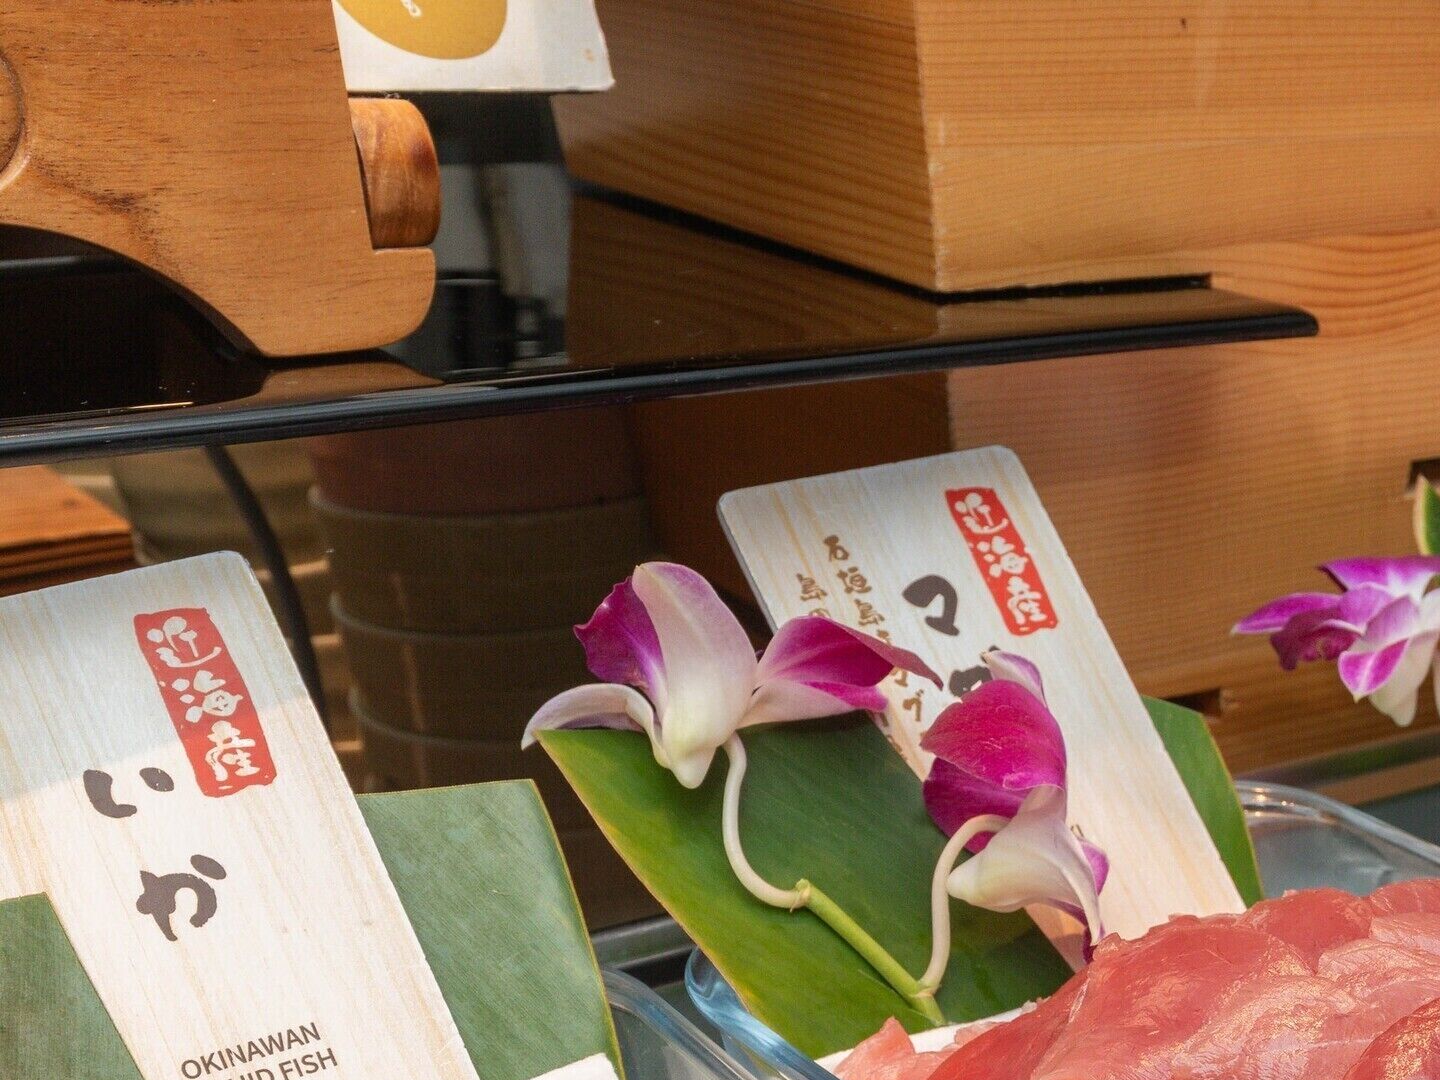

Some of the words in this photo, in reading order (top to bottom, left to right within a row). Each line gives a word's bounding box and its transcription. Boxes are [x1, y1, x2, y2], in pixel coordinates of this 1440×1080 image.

[954, 492, 1047, 626] 近海産
[146, 615, 261, 783] 近海産
[83, 768, 227, 942] いか
[180, 1021, 322, 1080] OKINAWAN
